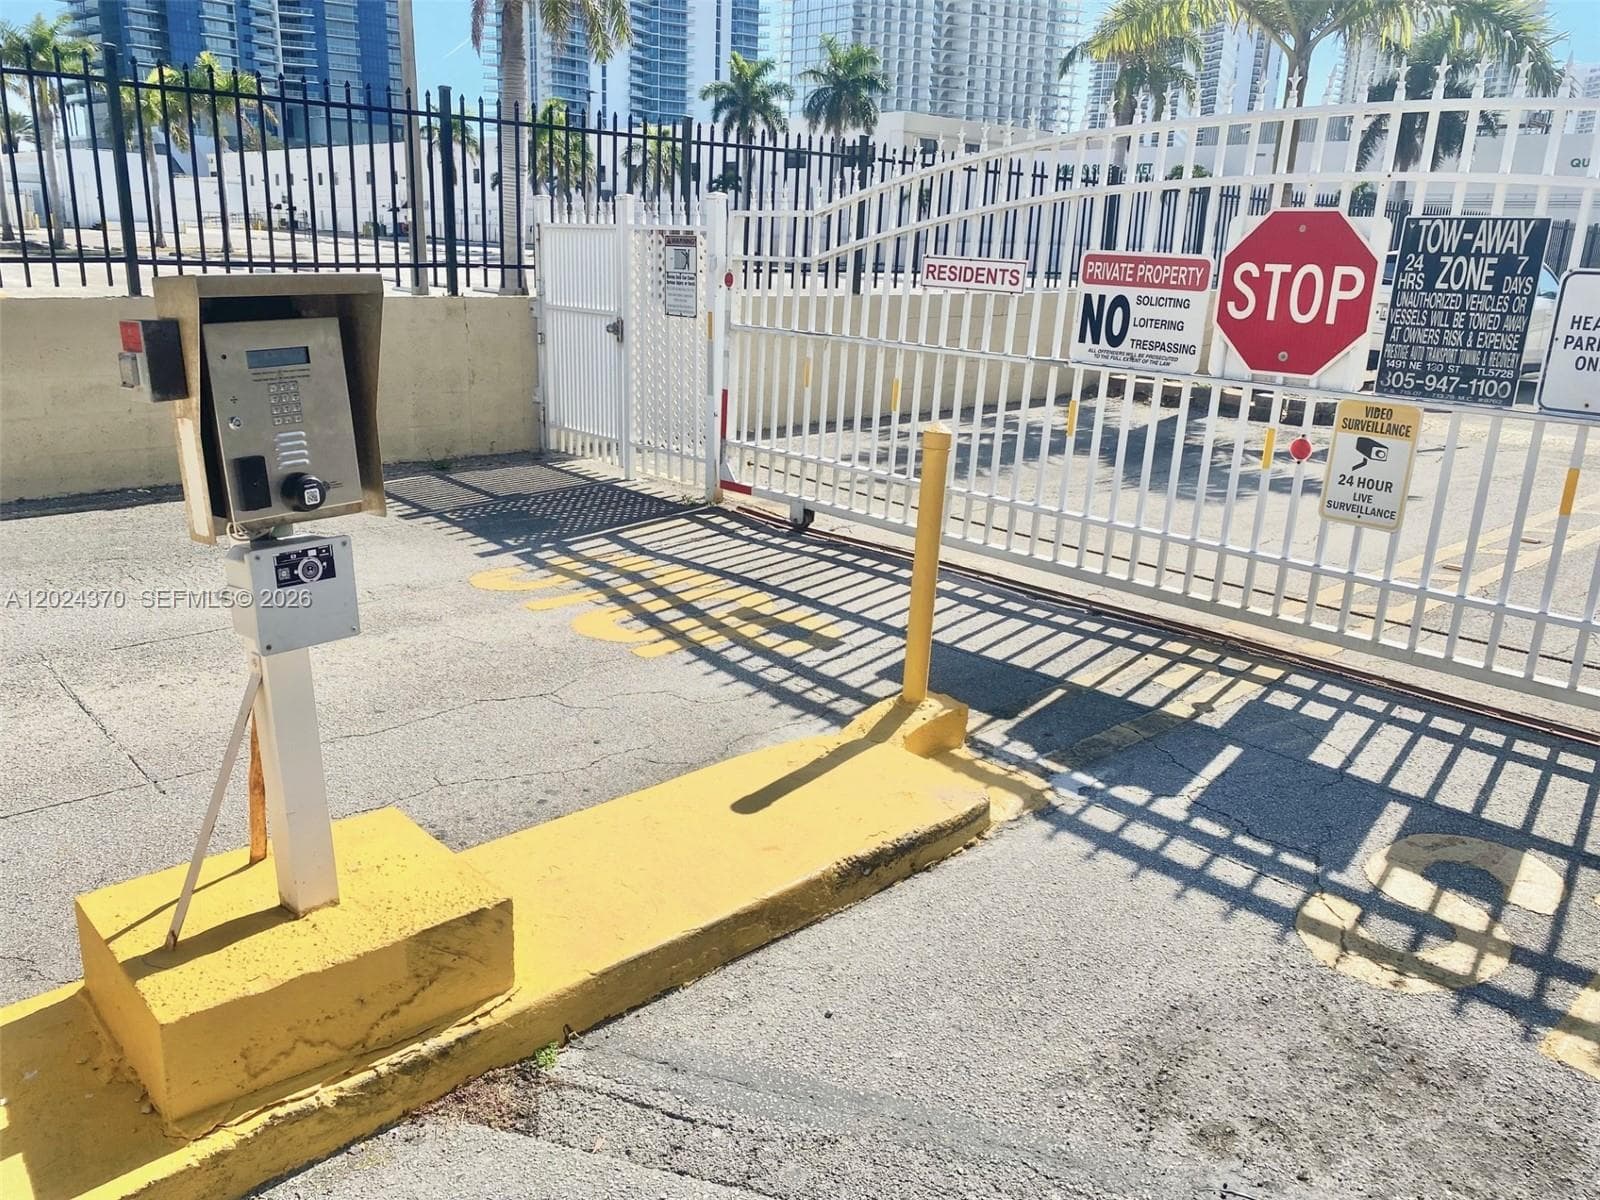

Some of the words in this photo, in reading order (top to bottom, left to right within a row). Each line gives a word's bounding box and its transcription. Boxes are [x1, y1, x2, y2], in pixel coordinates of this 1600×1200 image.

[1417, 218, 1535, 255] TOW-AWAY
[1404, 253, 1424, 272] 24
[1434, 255, 1498, 291] ZONE
[1516, 256, 1530, 275] 7
[925, 263, 1021, 286] RESIDENTS
[1086, 261, 1135, 282] PRIVATE
[1136, 262, 1205, 287] PROPERTY
[1397, 272, 1425, 291] HRS
[1226, 261, 1366, 325] STOP
[1502, 276, 1534, 296] DAYS
[1136, 295, 1191, 309] SOLICITING
[1396, 291, 1463, 310] UNAUTHORIZED
[1466, 293, 1510, 313] VEHICLES
[1512, 295, 1528, 314] OR
[1077, 292, 1131, 349] NO
[1133, 317, 1185, 331] LOITERING
[1390, 308, 1428, 326] VESSELS
[1430, 310, 1449, 327] WILL
[1452, 312, 1467, 328] BE
[1469, 312, 1501, 331] TOWED
[1502, 314, 1529, 333] AWAY
[1130, 338, 1197, 356] TRESPASSING
[1390, 326, 1402, 342] AT
[1402, 327, 1441, 345] OWNERS
[1442, 328, 1465, 347] RISK
[1466, 331, 1474, 348] &
[1476, 331, 1521, 351] EXPENSE
[1386, 359, 1406, 369] 1491
[1409, 361, 1423, 370] NE
[1476, 367, 1514, 379] TL5728
[1380, 370, 1512, 399] 305-947-1100
[1365, 405, 1394, 421] VIDEO
[1341, 417, 1412, 438] SURVEILLANCE
[1337, 473, 1354, 487] 24
[1356, 476, 1394, 494] HOUR
[1353, 492, 1374, 504] LIVE
[1326, 499, 1397, 521] SURVEILLANCE
